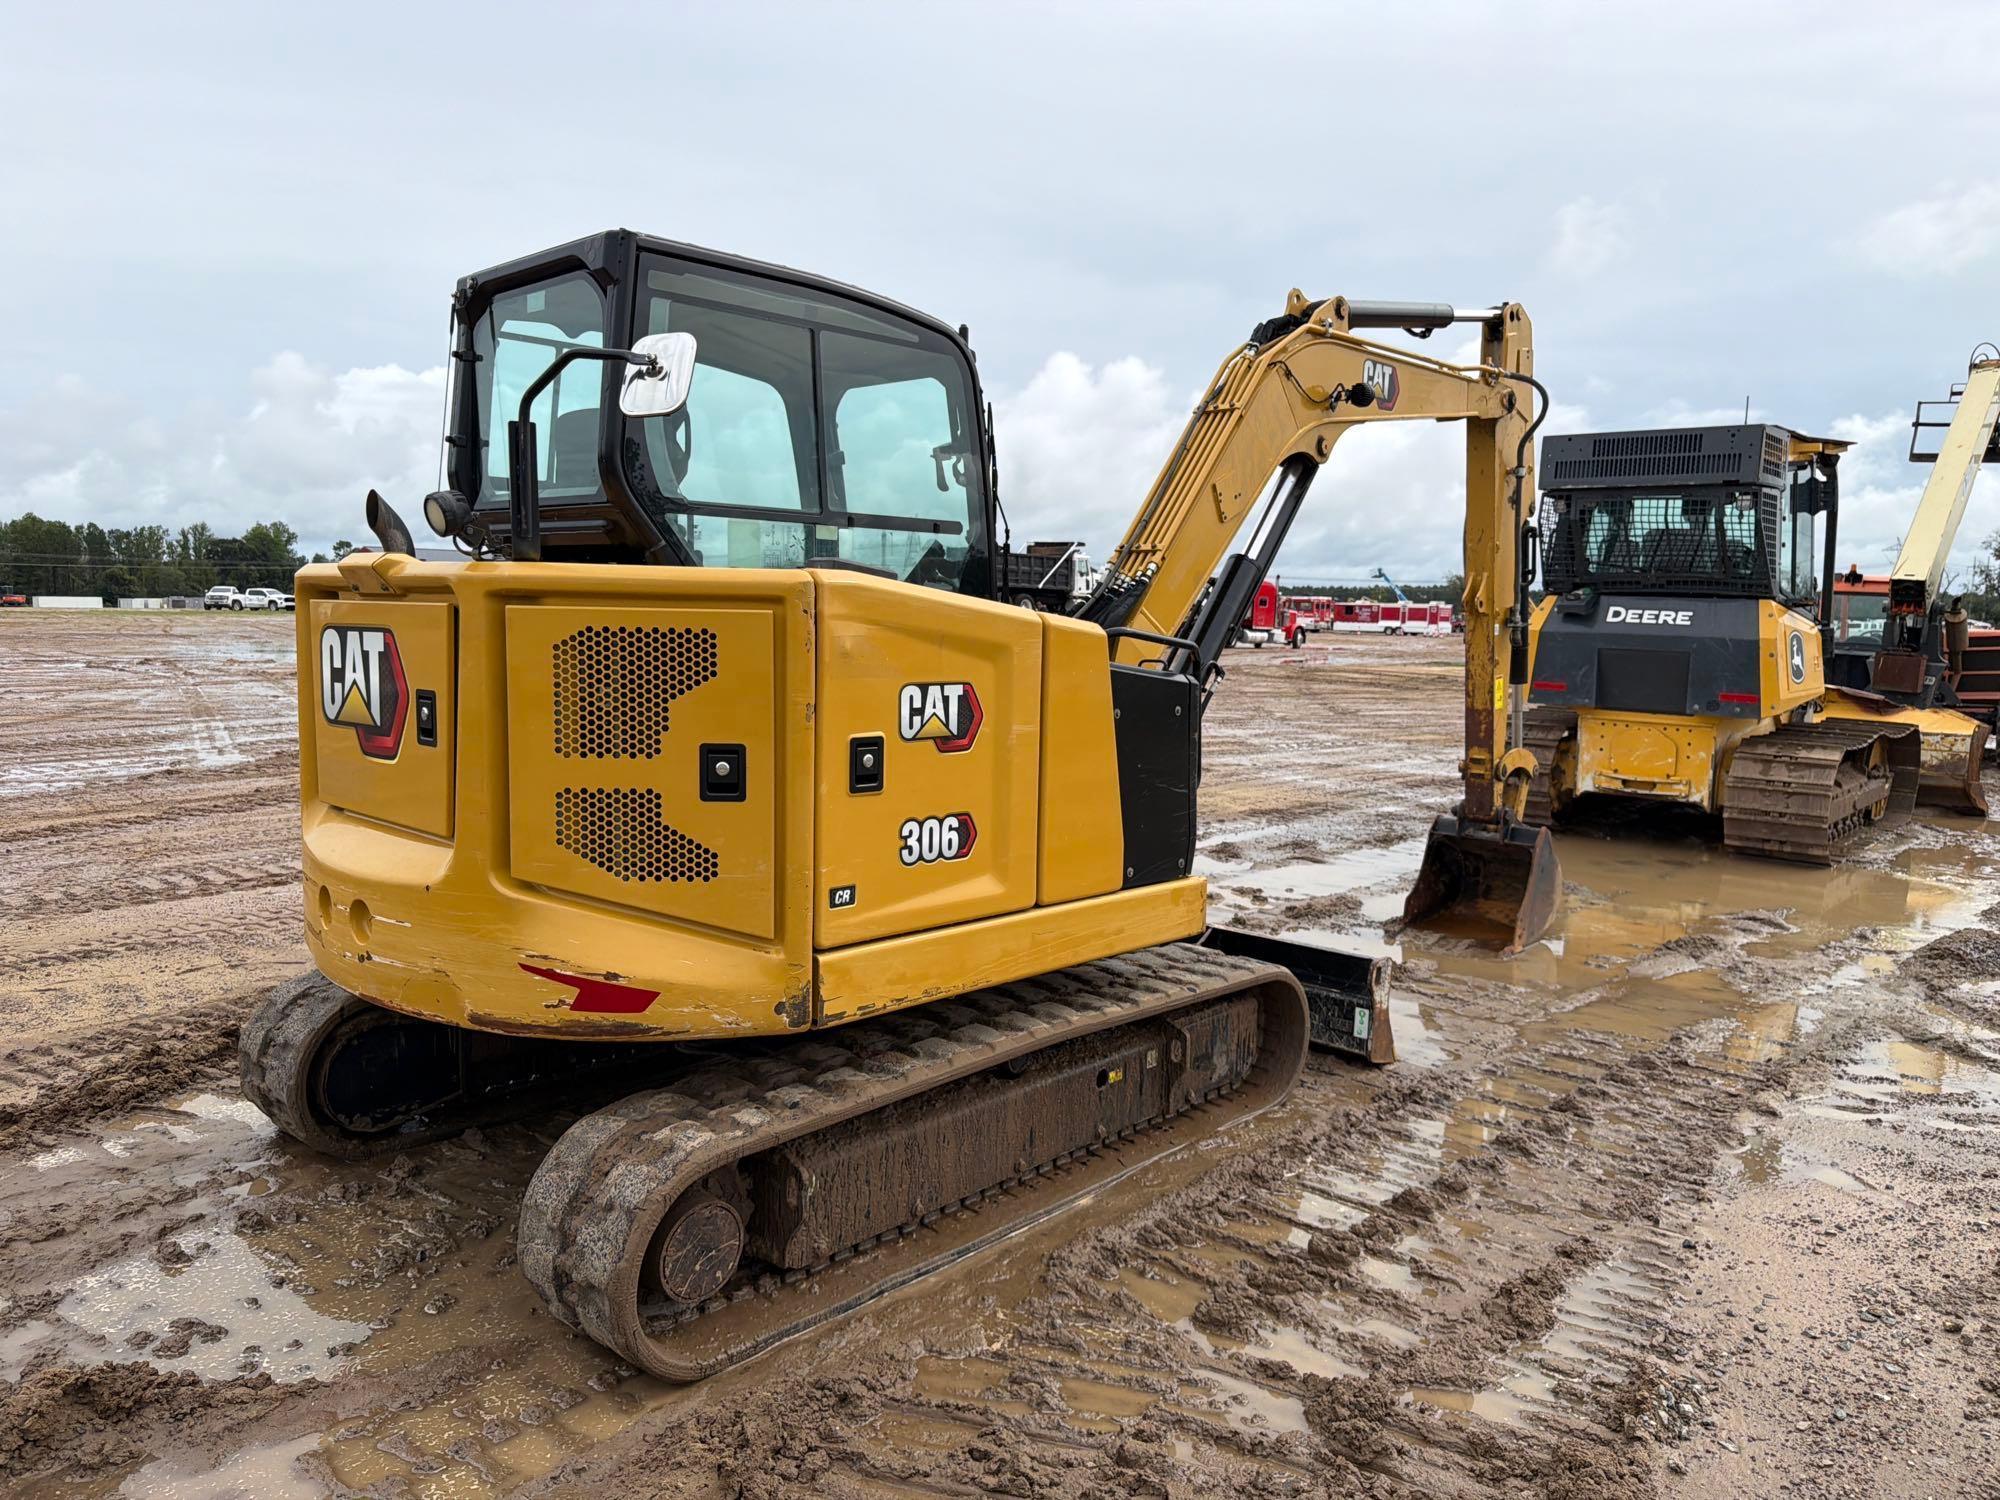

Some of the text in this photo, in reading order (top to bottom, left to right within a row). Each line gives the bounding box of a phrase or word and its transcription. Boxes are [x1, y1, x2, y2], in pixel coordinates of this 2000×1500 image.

[1363, 360, 1393, 400] CAT
[1606, 605, 1694, 626] DEERE
[322, 628, 386, 727] CAT
[900, 683, 964, 740] CAT
[901, 816, 959, 866] 306
[835, 889, 851, 904] CR
